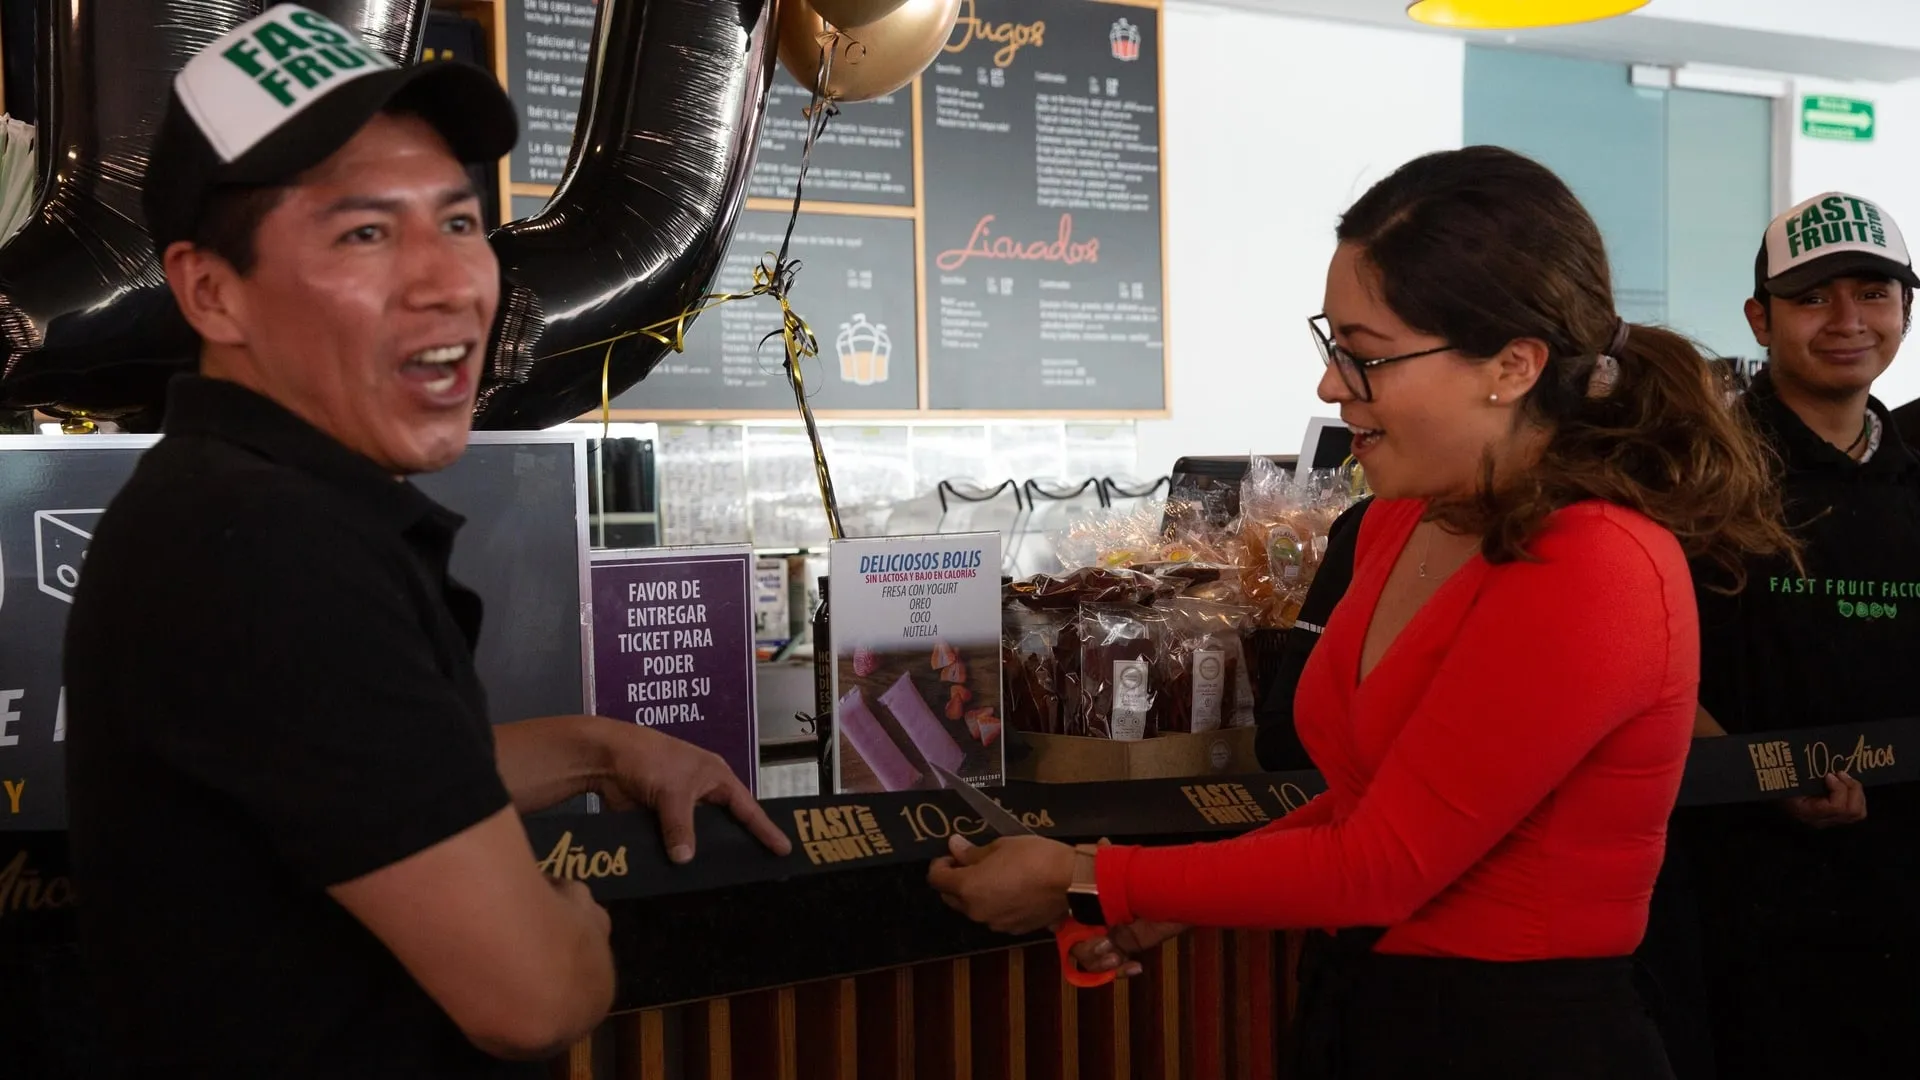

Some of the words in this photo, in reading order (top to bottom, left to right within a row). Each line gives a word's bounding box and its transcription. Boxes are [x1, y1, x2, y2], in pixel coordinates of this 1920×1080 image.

[1786, 196, 1864, 236] FAST
[1788, 221, 1868, 258] FRUIT
[860, 553, 940, 574] DELICIOSOS
[942, 550, 982, 569] BOLIS
[865, 574, 877, 584] SIN
[879, 572, 909, 583] LACTOSA
[915, 570, 932, 580] BAJO
[933, 570, 943, 580] EN
[944, 568, 977, 579] CALORÍAS
[1770, 577, 1816, 594] FAST
[1826, 579, 1875, 596] FRUIT
[629, 581, 677, 602] FAVOR
[681, 579, 701, 599] DE
[882, 585, 906, 598] FRESA
[908, 584, 925, 596] CON
[927, 582, 959, 596] YOGURT
[627, 604, 707, 627] ENTREGAR
[910, 597, 931, 610] OREO
[910, 611, 931, 624] COCO
[618, 631, 670, 653] TICKET
[674, 628, 713, 649] PARA
[903, 624, 938, 638] NUTELLA
[643, 654, 694, 676] PODER
[628, 679, 687, 702] RECIBIR
[691, 677, 711, 697] SU
[635, 703, 705, 726] COMPRA.
[1748, 741, 1785, 769] FAST
[1781, 741, 1799, 788] FACTORY
[1804, 741, 1829, 780] 10
[1831, 734, 1895, 773] Años
[1756, 767, 1790, 791] FRUIT
[1181, 783, 1245, 808] FAST
[1268, 782, 1309, 814] 10
[793, 804, 860, 842] FAST
[900, 802, 951, 842] 10
[1198, 805, 1256, 825] FRUIT
[853, 804, 894, 855] FACTORY
[536, 830, 629, 880] Años
[803, 834, 874, 866] FRUIT
